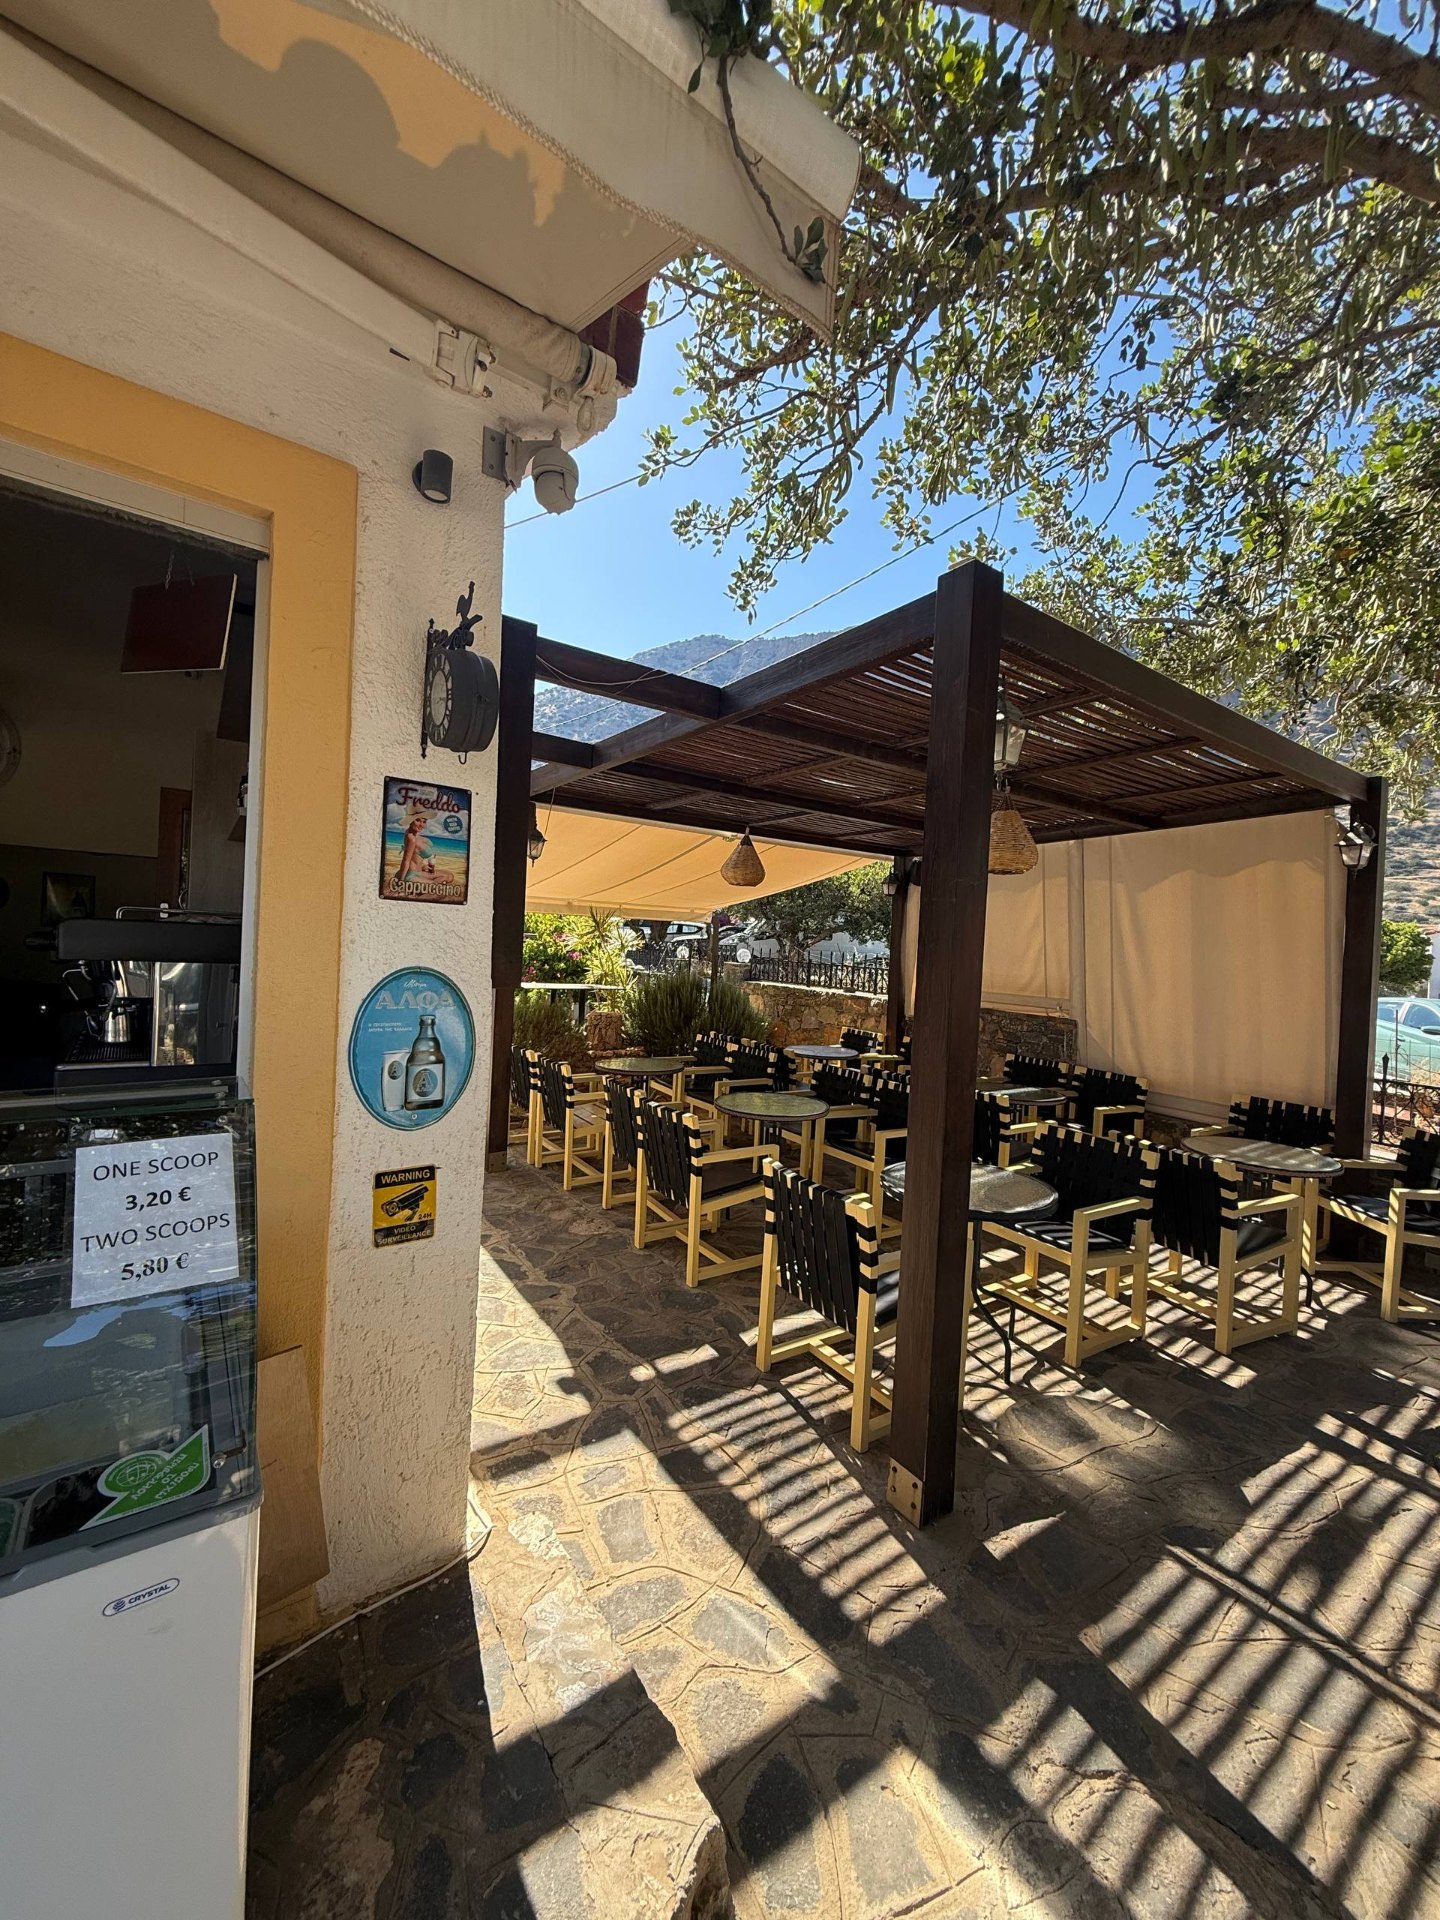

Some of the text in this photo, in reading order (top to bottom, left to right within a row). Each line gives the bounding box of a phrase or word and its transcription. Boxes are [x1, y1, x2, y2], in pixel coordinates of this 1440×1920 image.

[396, 786, 463, 813] Freddo
[389, 877, 461, 896] Cappuccino
[93, 1151, 219, 1181] ONE SCOOP
[381, 1169, 430, 1184] WARNING
[125, 1186, 191, 1212] 3,20 €
[80, 1213, 230, 1253] TWO SCOOPS
[377, 1229, 432, 1245] SURVEILLANCE
[394, 1225, 416, 1234] VIDEO
[121, 1252, 190, 1282] 5,80 €
[128, 1584, 171, 1604] CRYSTAL
